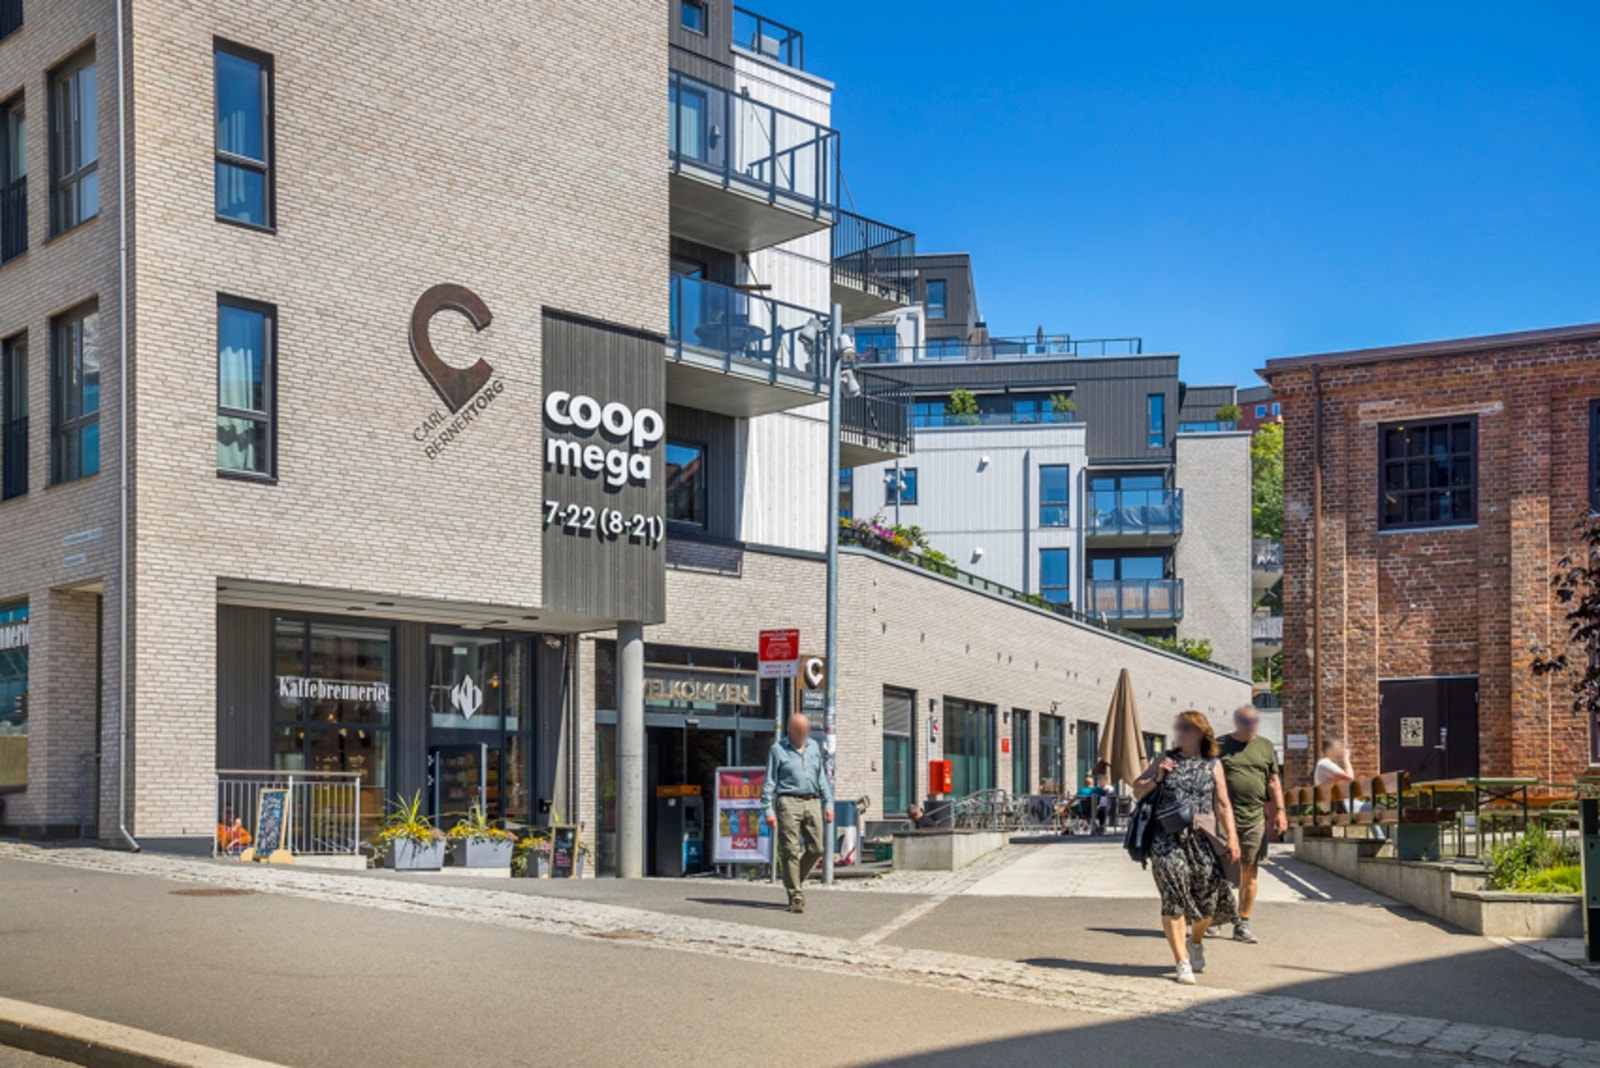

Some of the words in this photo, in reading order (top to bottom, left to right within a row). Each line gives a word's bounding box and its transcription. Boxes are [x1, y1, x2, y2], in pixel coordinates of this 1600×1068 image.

[413, 409, 447, 442] CARL
[424, 380, 504, 460] BERNERTORG
[545, 391, 664, 447] coop
[547, 438, 651, 486] mega
[545, 500, 596, 530] 7-22
[600, 507, 664, 543] (8-21)
[279, 676, 391, 702] Kaffebrenneriet
[720, 784, 761, 798] TILBU
